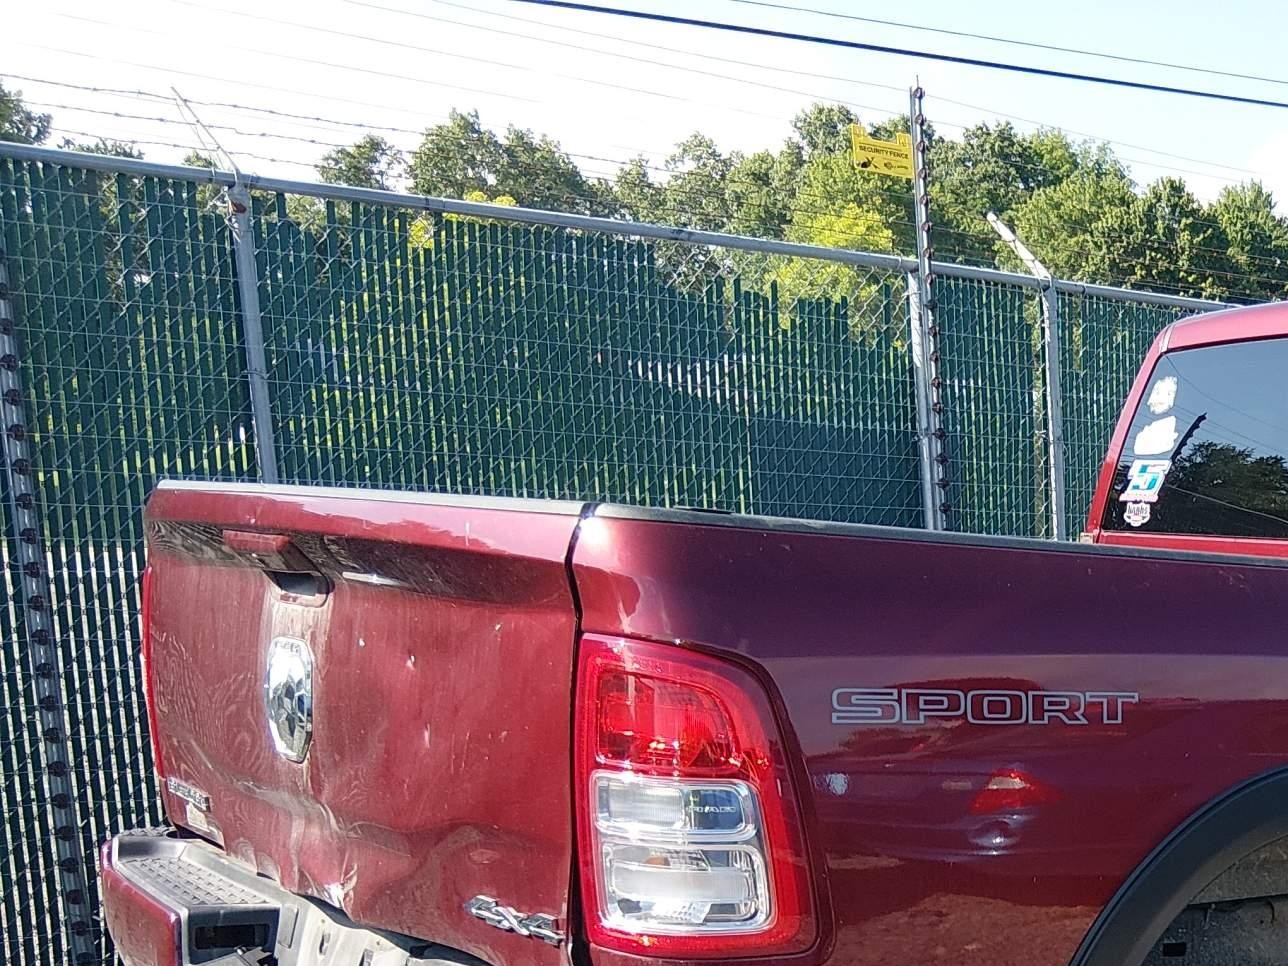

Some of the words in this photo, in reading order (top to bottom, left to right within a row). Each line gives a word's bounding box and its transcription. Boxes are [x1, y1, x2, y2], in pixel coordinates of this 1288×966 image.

[858, 144, 889, 157] SECURITY
[889, 150, 909, 160] FENCE
[830, 687, 1139, 726] SPORT
